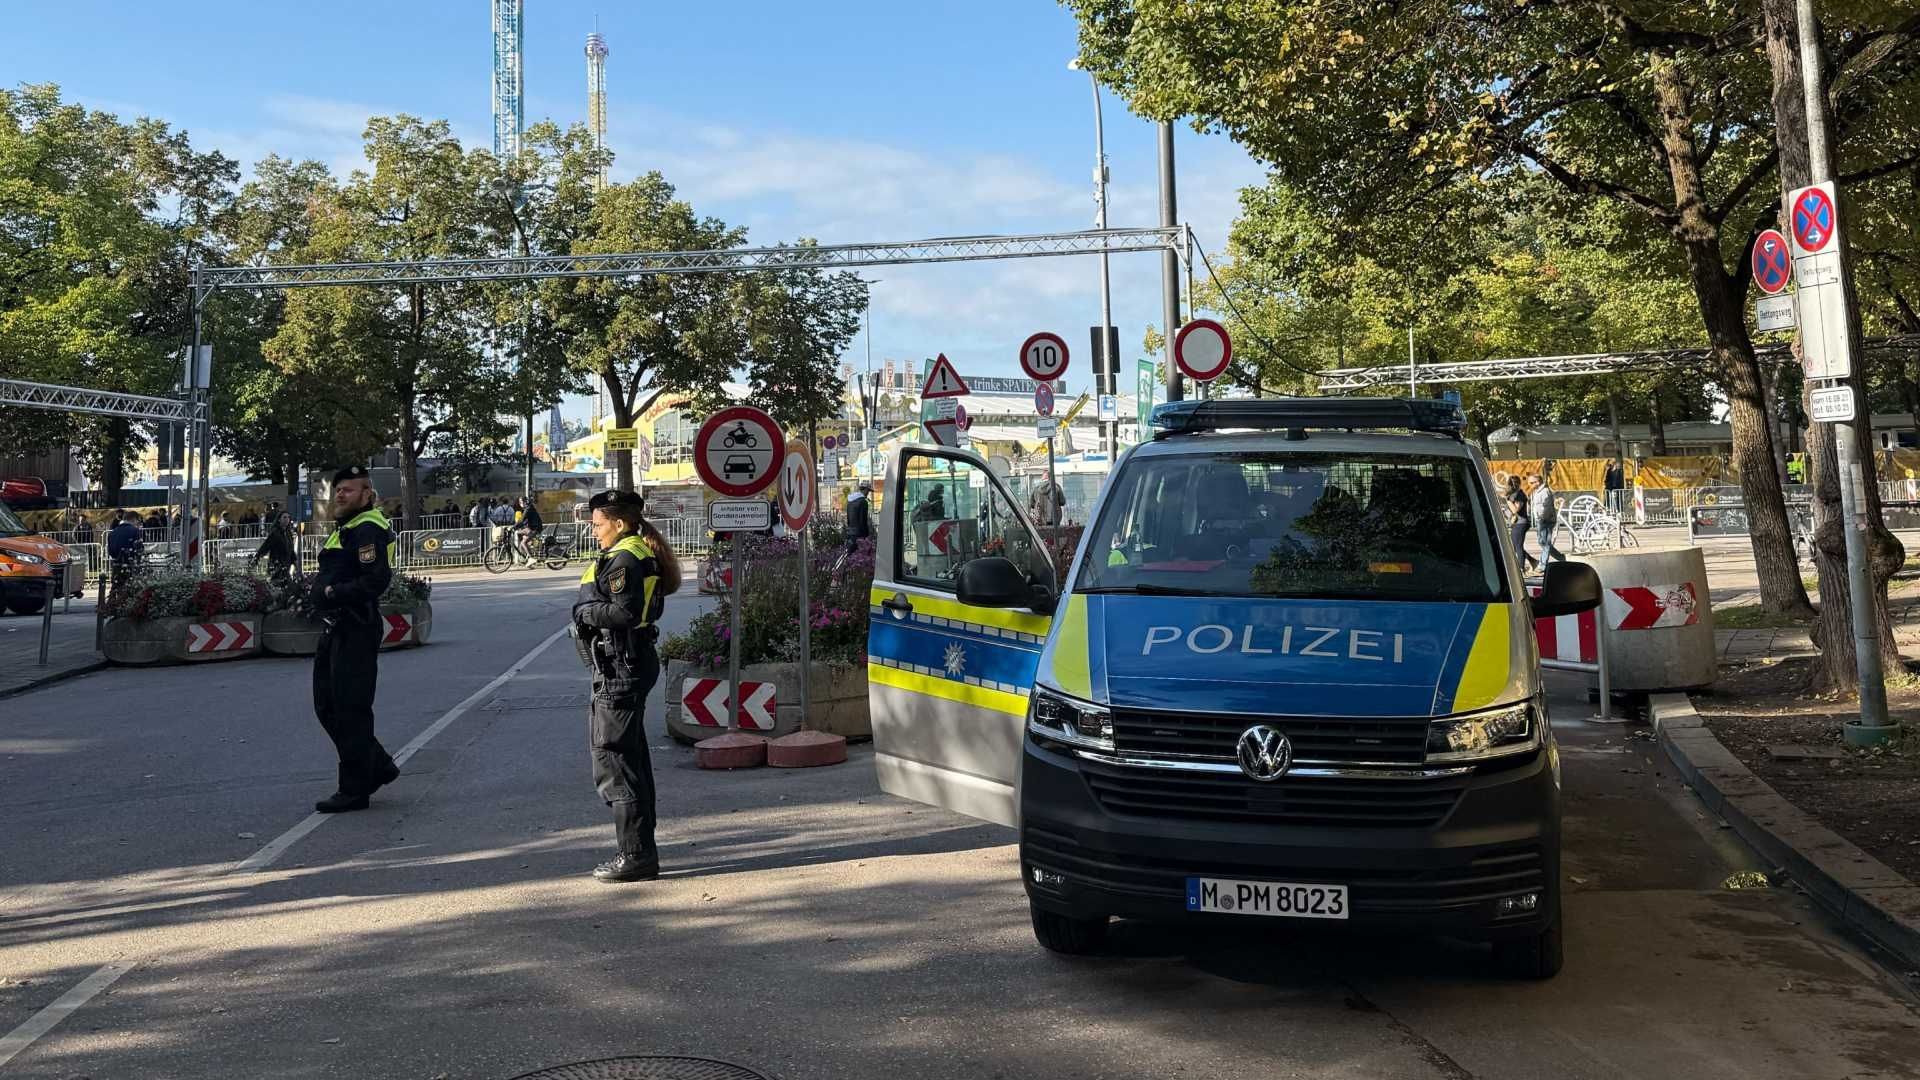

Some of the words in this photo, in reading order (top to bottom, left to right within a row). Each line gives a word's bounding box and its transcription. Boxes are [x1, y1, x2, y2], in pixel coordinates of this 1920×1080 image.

[1033, 346, 1056, 368] 10
[1142, 624, 1403, 664] POLIZEI
[1201, 882, 1218, 908] M
[1236, 884, 1270, 911] PM
[1276, 886, 1344, 915] 8023
